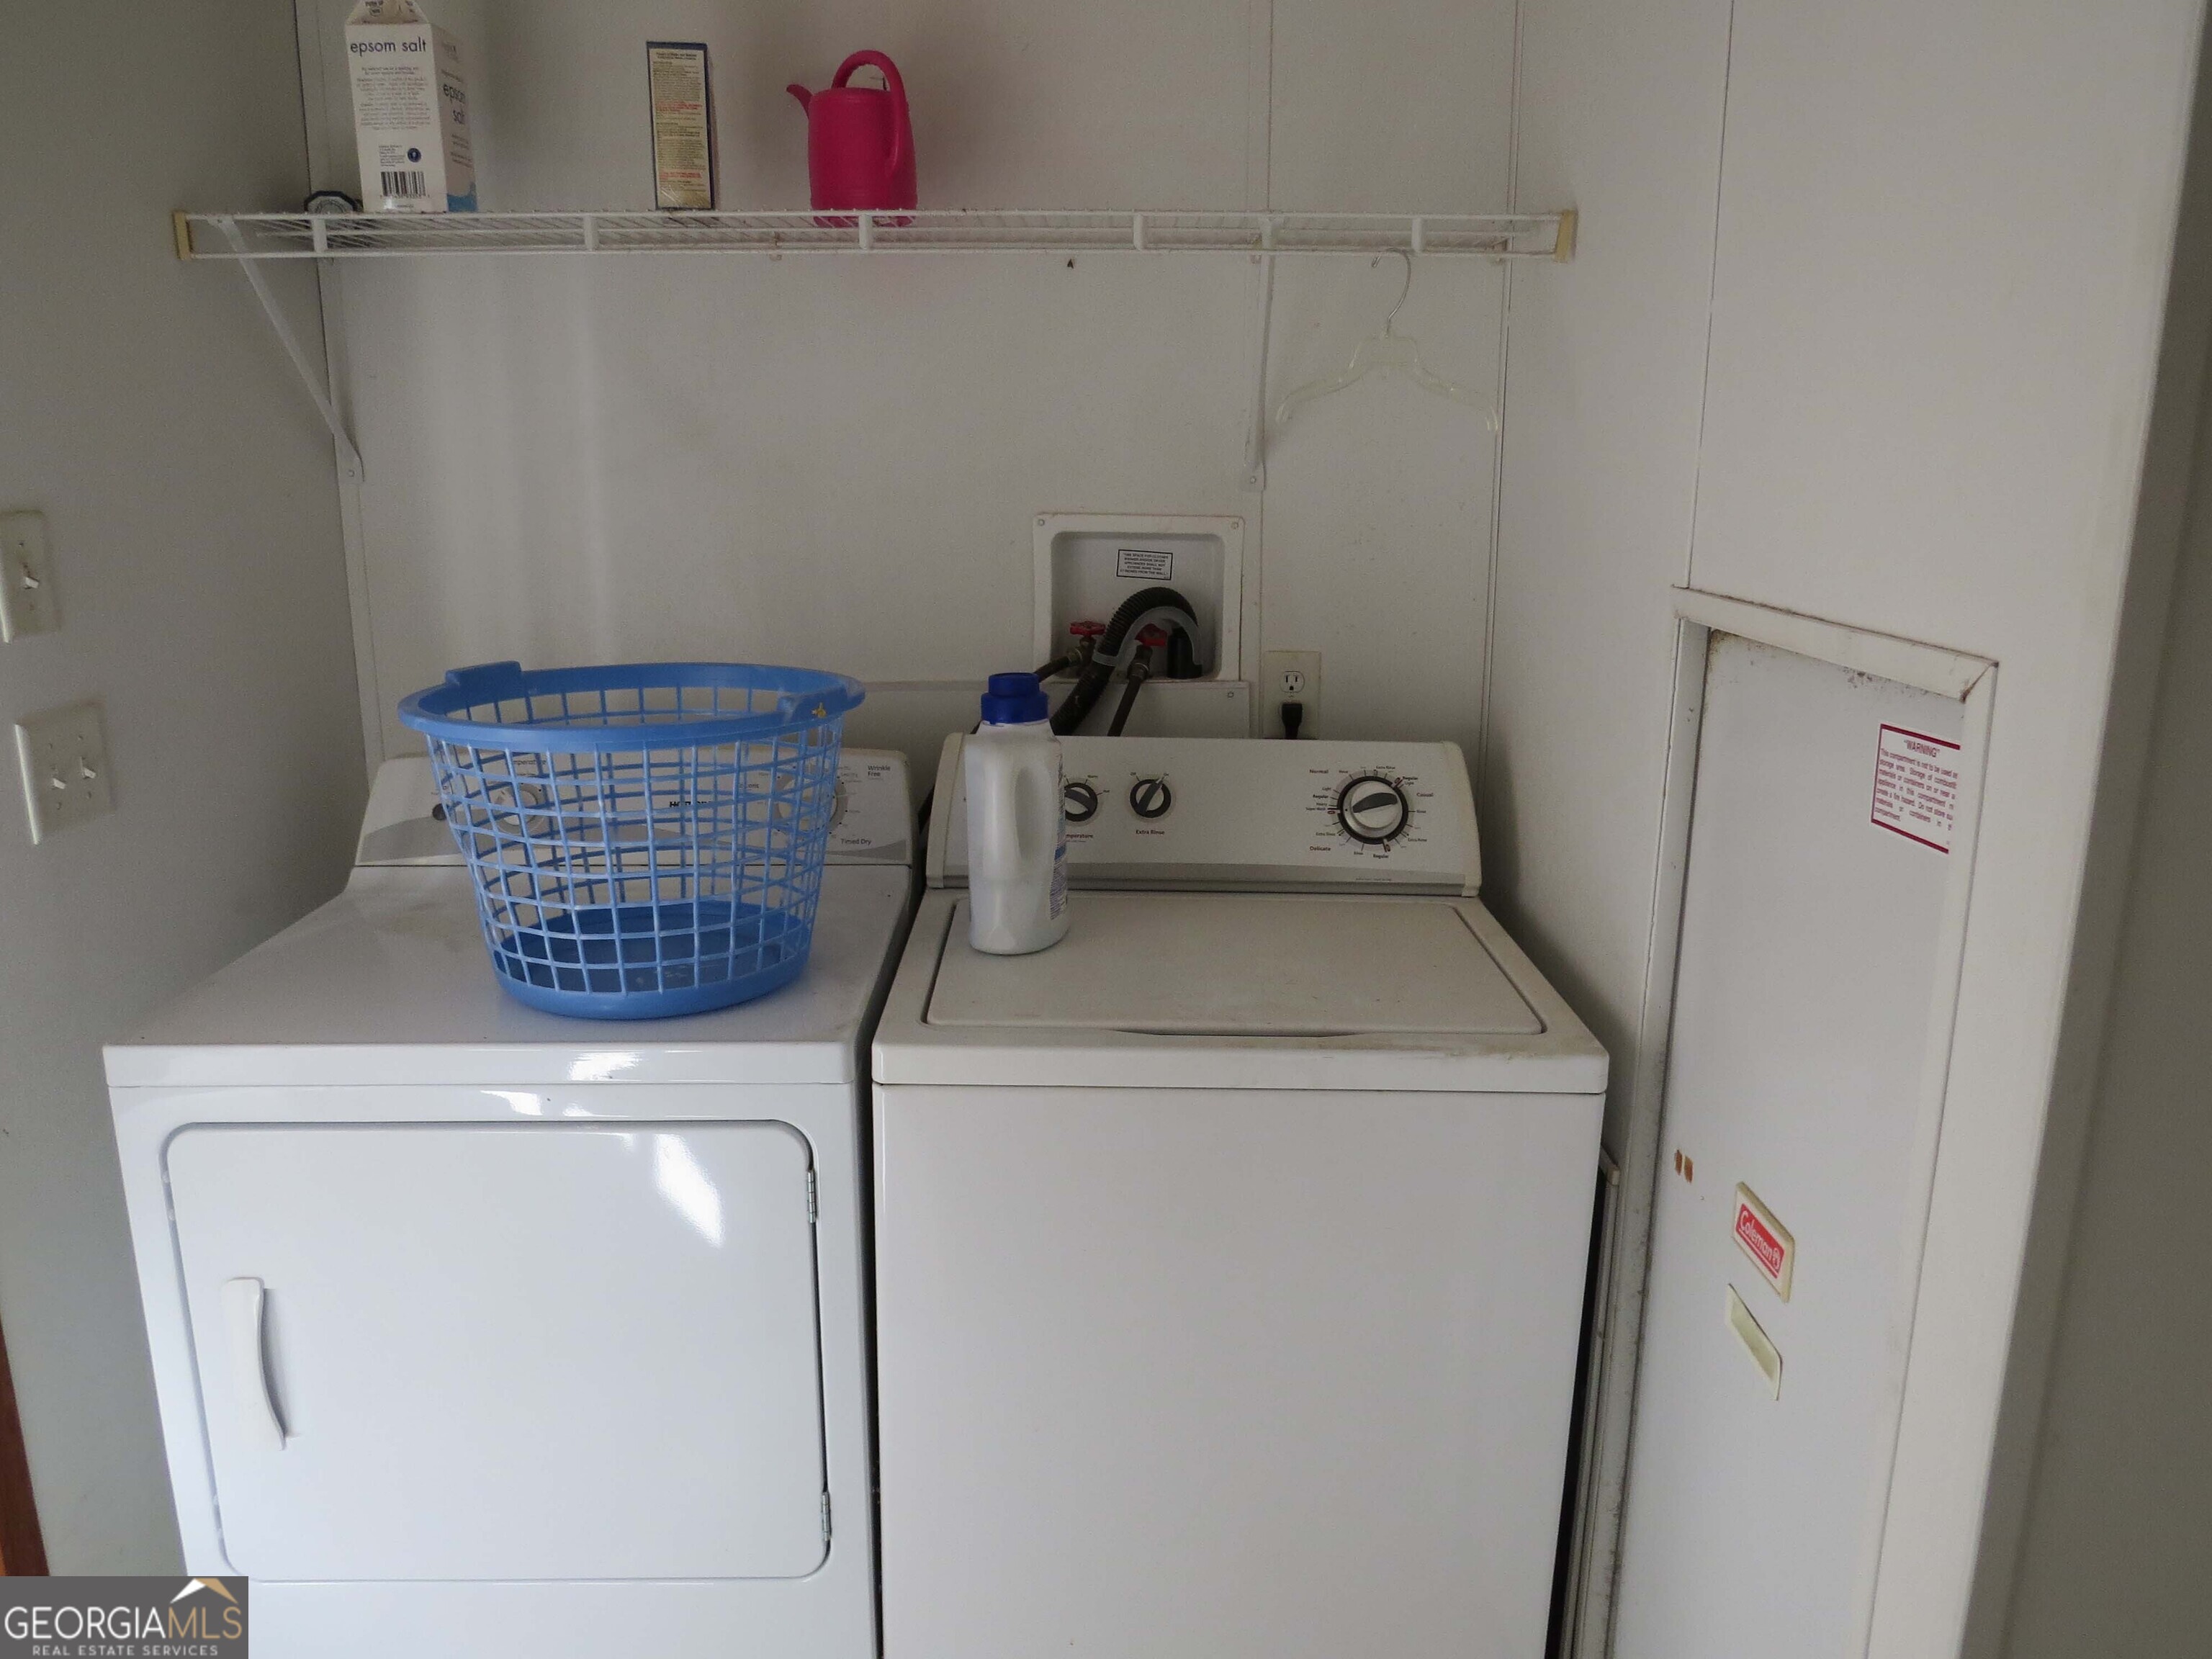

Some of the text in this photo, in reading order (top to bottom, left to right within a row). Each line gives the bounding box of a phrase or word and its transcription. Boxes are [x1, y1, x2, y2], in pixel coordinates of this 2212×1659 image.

[351, 37, 427, 57] epsom salt
[1740, 1210, 1773, 1261] Coleman
